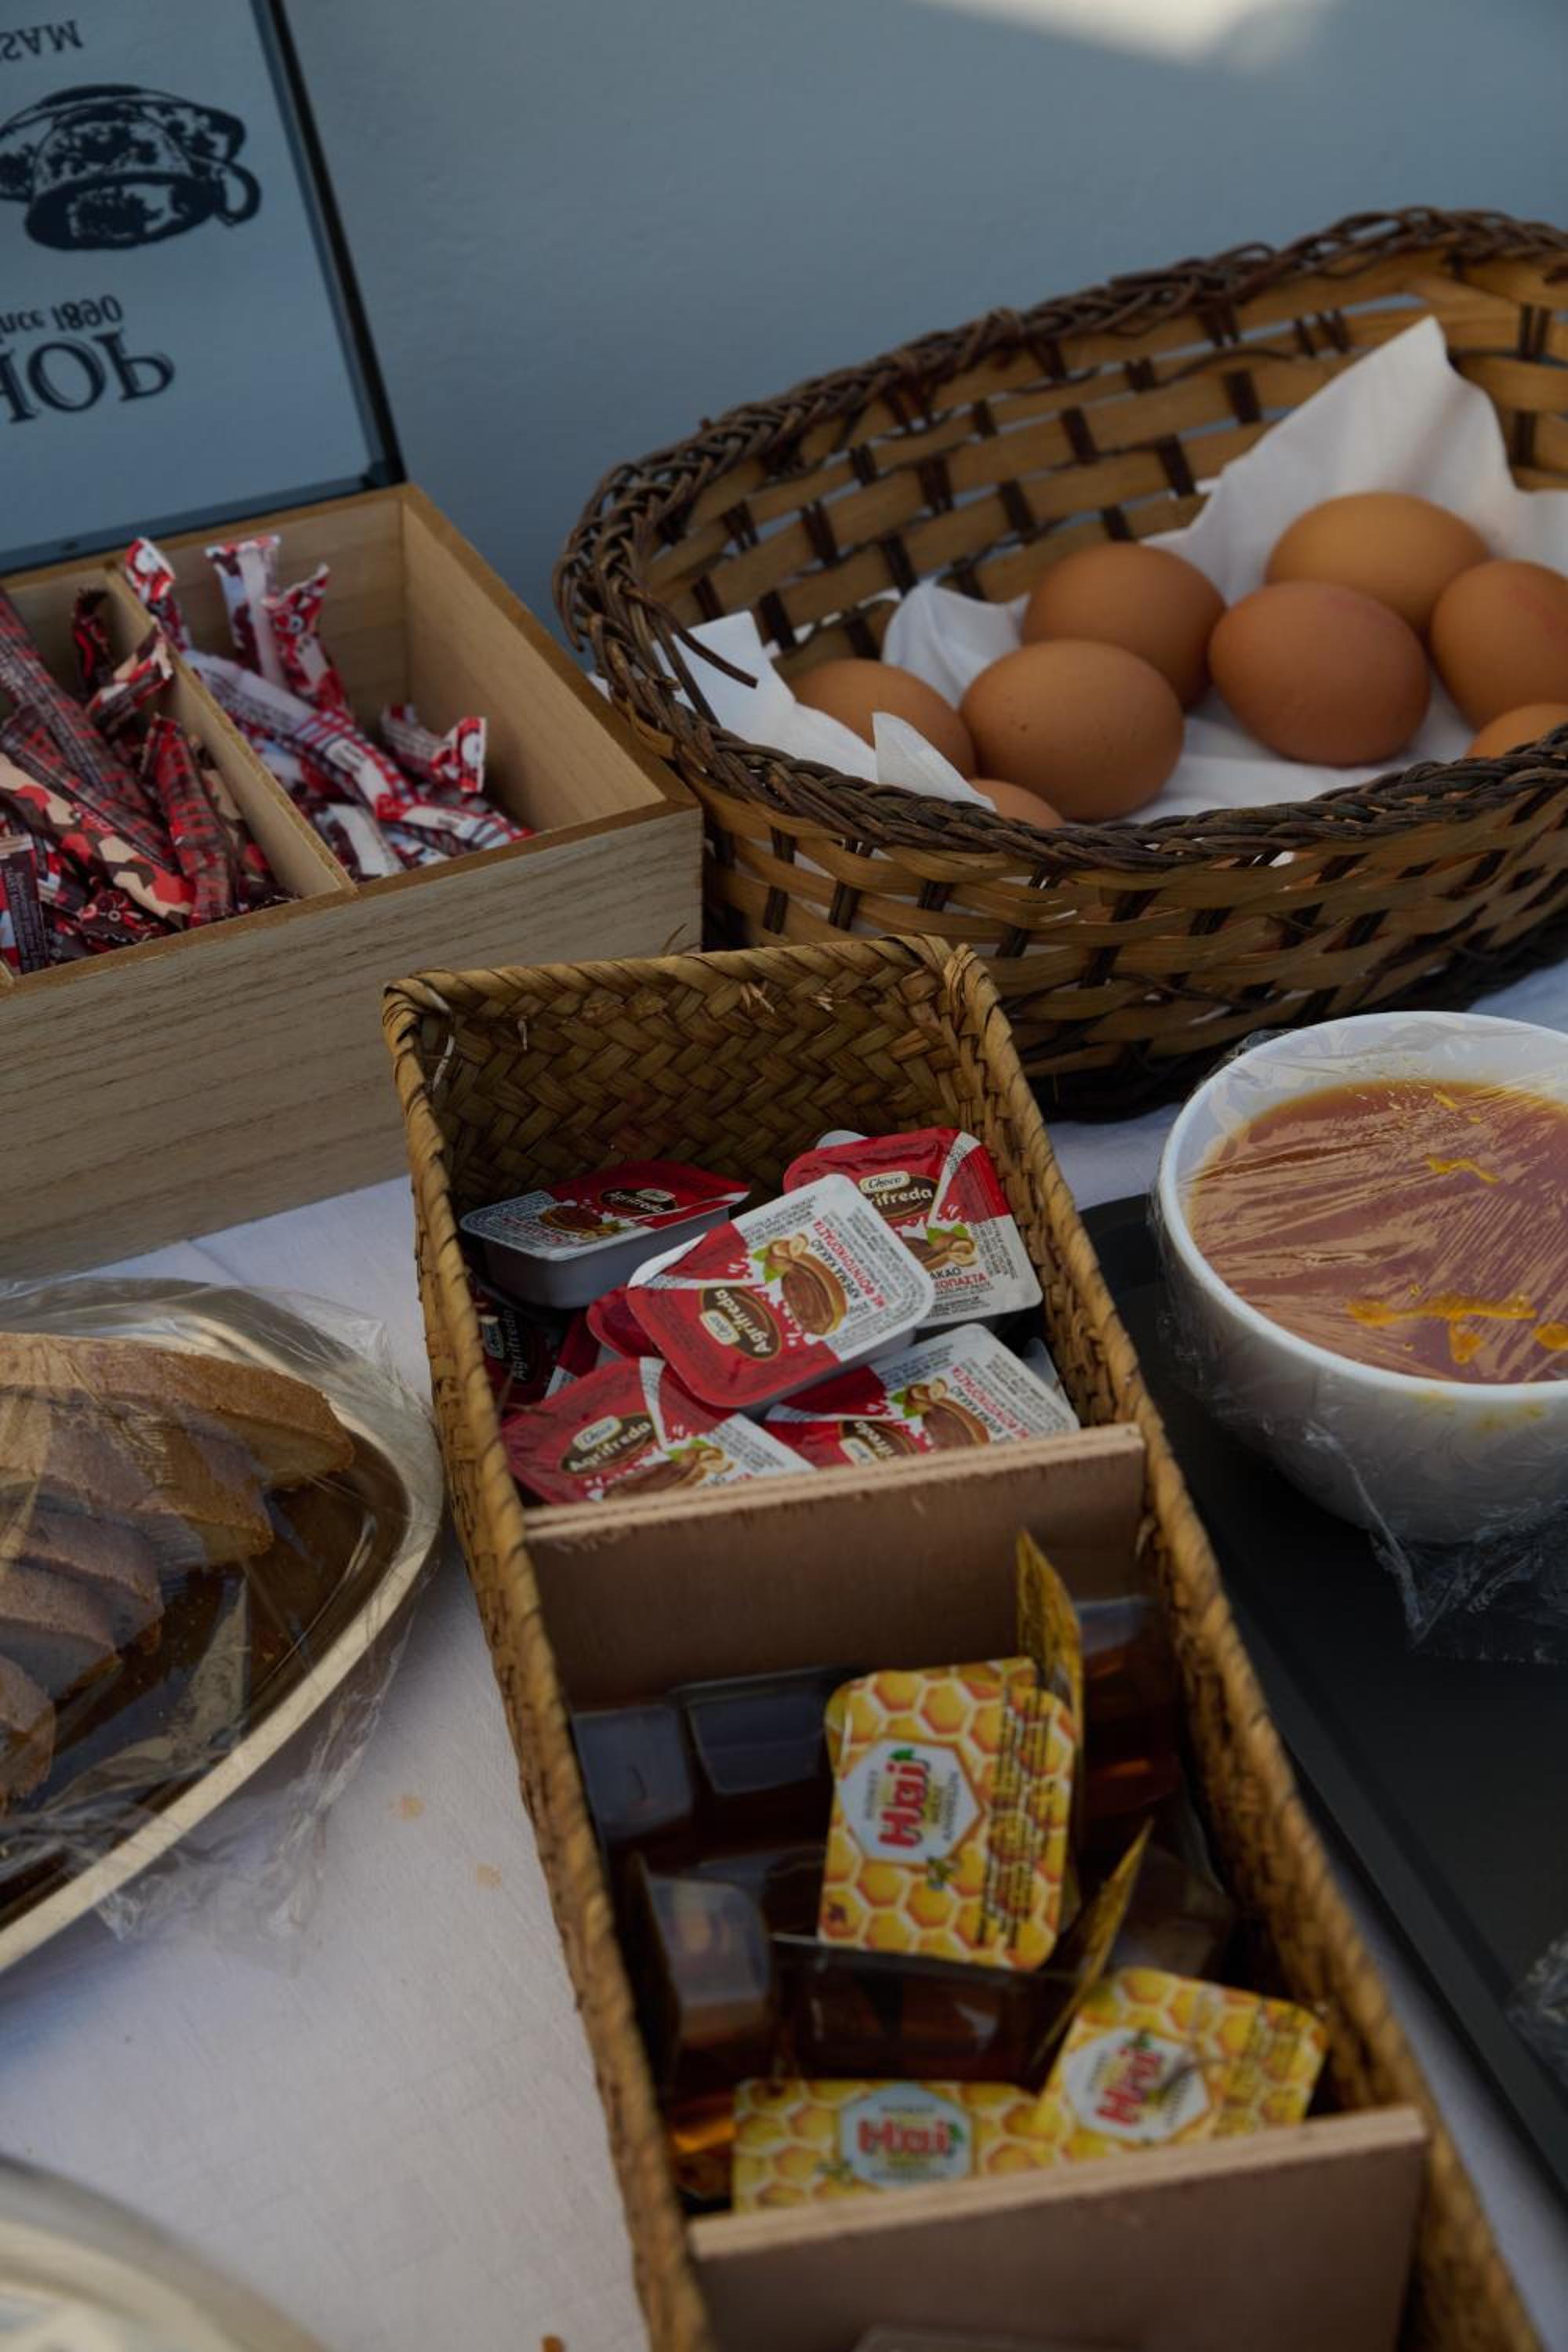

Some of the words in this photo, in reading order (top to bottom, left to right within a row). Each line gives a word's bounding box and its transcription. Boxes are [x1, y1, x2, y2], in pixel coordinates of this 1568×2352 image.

[929, 1266, 962, 1280] ΑΚΑΟ
[714, 1288, 772, 1354] Agrifreda
[568, 1421, 653, 1472] Agrifreda
